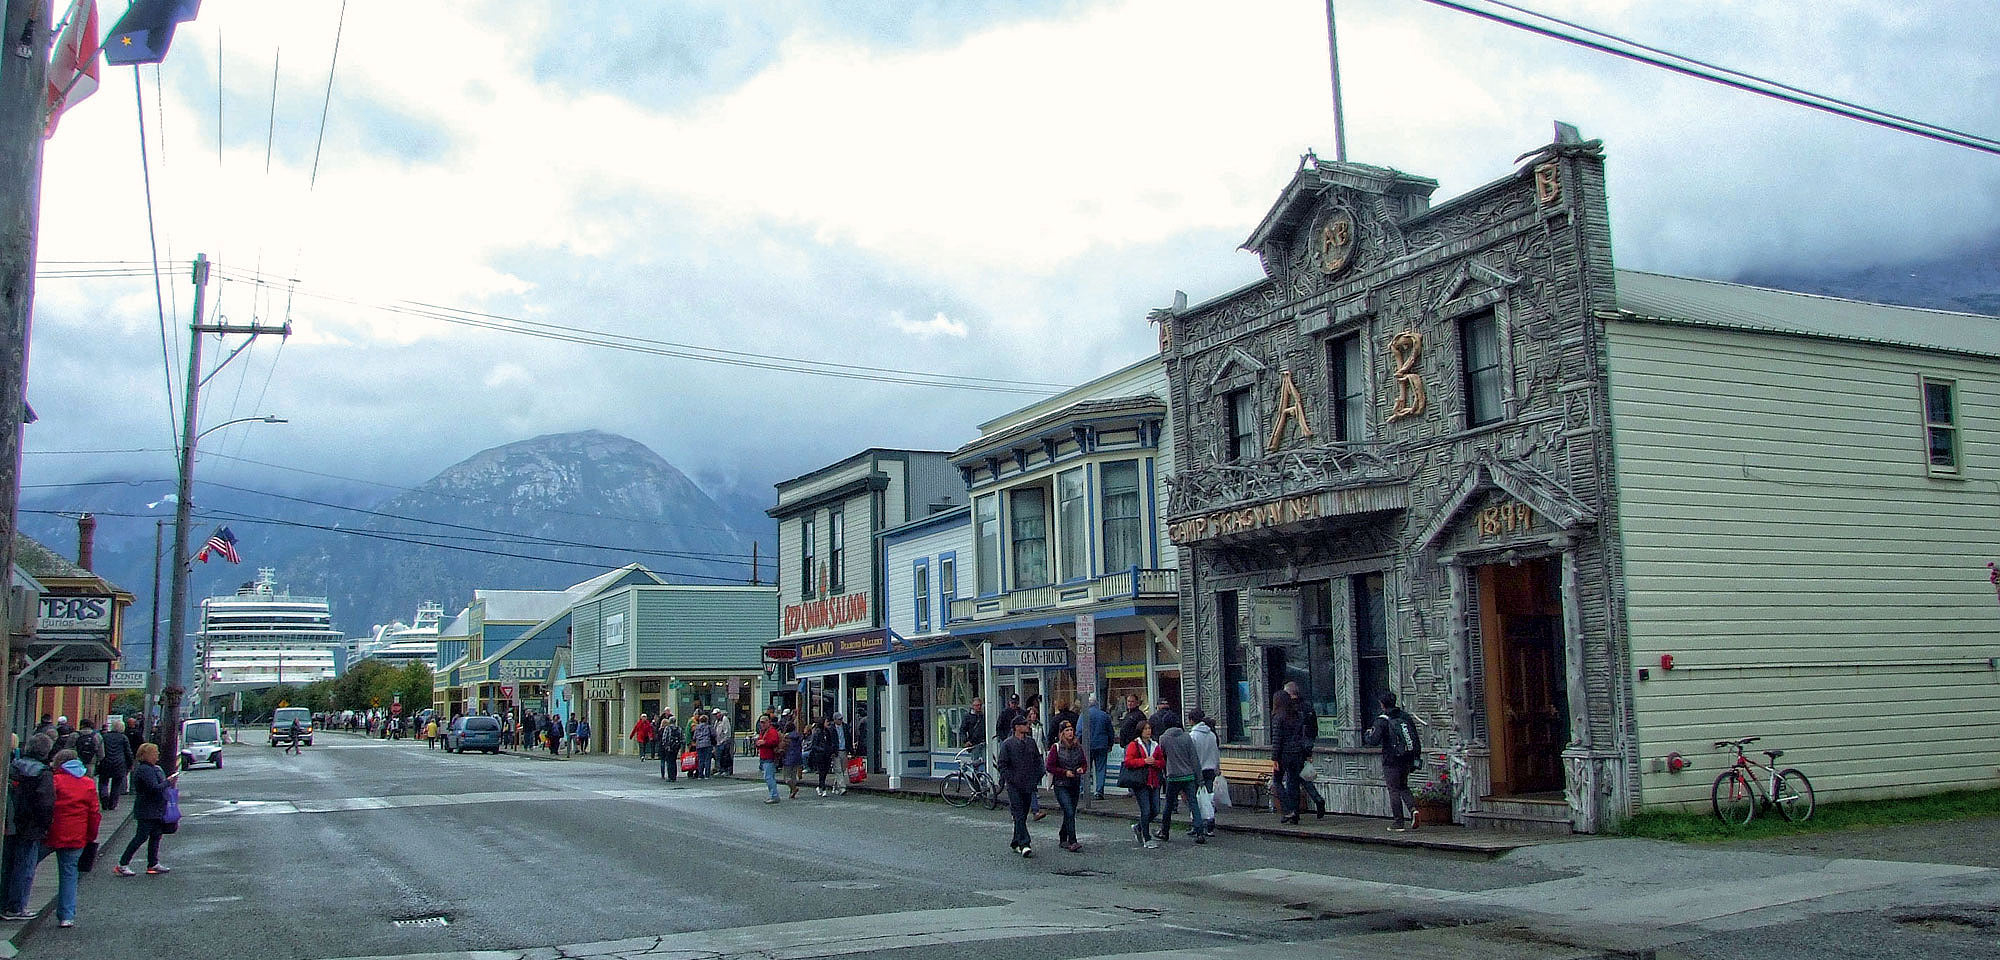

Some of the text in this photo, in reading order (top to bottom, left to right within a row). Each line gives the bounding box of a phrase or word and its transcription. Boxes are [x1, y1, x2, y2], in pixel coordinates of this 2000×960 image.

[1535, 163, 1559, 201] B
[1268, 331, 1426, 451] A B
[1168, 517, 1207, 542] CAMP
[784, 592, 867, 636] RED ONION SALOON
[801, 641, 834, 658] MILANO
[587, 689, 614, 699] LOOM
